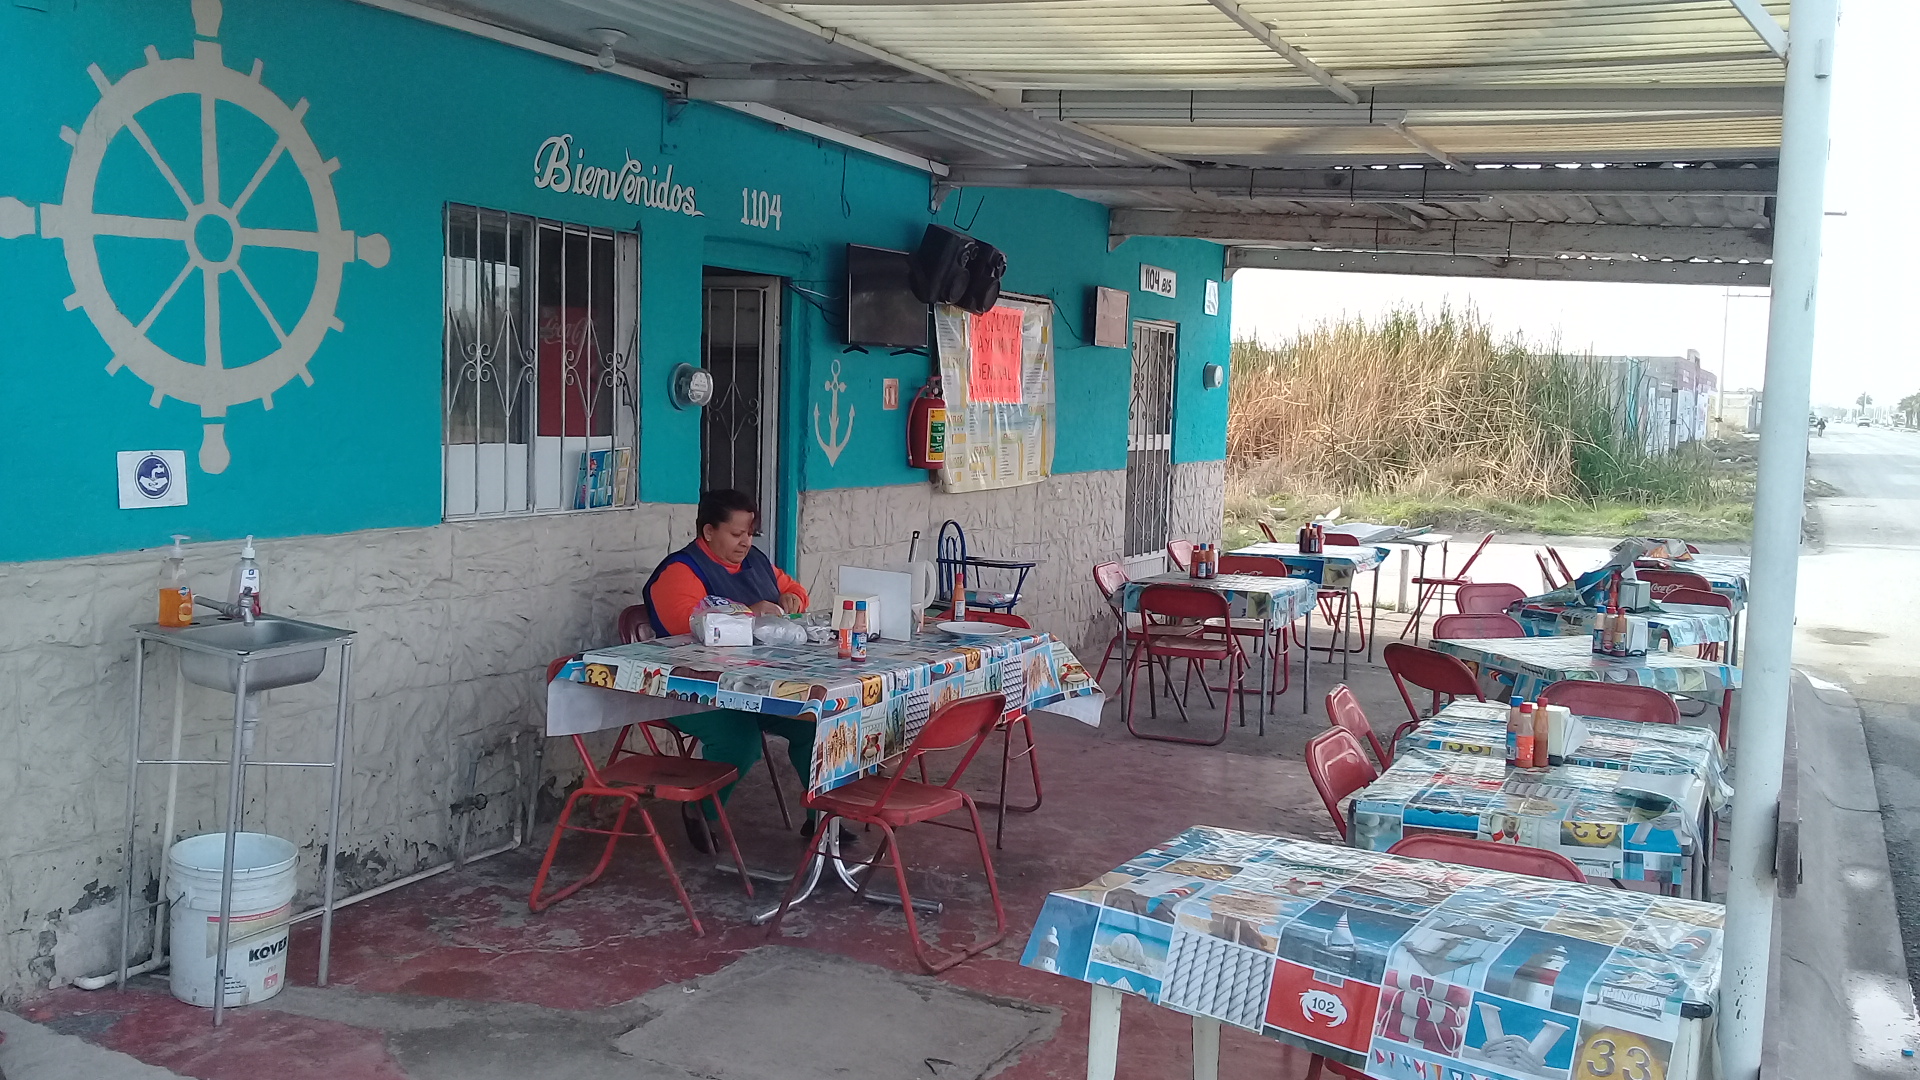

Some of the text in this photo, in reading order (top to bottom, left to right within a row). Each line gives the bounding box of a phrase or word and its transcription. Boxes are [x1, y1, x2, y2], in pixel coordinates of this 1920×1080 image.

[740, 187, 782, 231] 1104
[1145, 268, 1172, 294] 1104 BIS
[1312, 997, 1336, 1014] 102
[1586, 1038, 1652, 1080] 33
